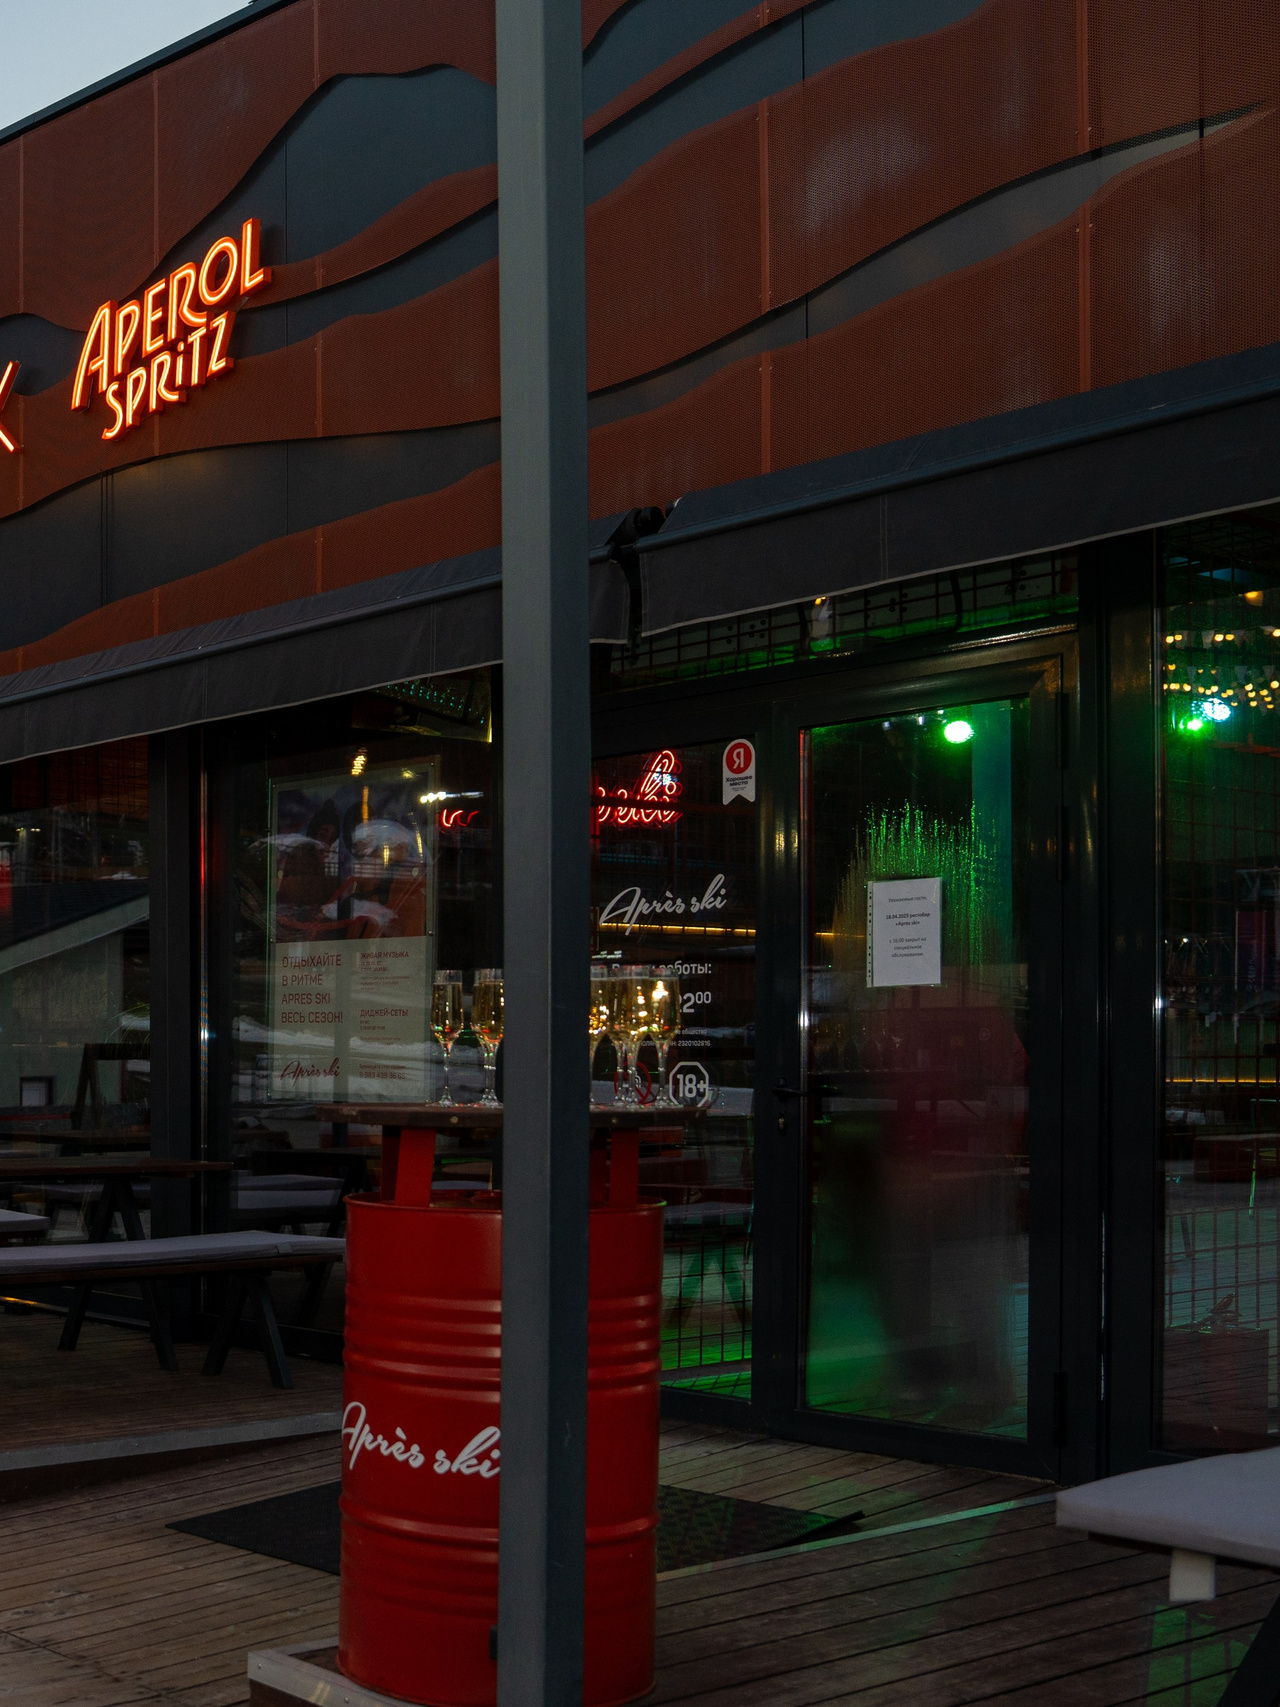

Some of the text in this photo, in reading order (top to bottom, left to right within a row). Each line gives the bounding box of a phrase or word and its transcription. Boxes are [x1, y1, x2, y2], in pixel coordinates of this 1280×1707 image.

[71, 218, 270, 411] APEROL
[732, 747, 745, 769] Я
[599, 873, 727, 936] Après ski
[909, 911, 930, 919] рестобар
[282, 953, 342, 969] ОТДЫХАЙТЕ
[360, 951, 409, 960] ЖИВАЯ МУЗЫКА
[281, 974, 323, 987] В РИТМЕ
[281, 993, 331, 1005] APRES SKI
[281, 1011, 343, 1023] ВЕСЬ СЕЗОН!
[360, 1008, 408, 1018] ДИДЖЕЙ-СЕТЫ
[280, 1057, 340, 1087] Après ski
[676, 1073, 707, 1098] 18+
[342, 1401, 501, 1479] Après ski
